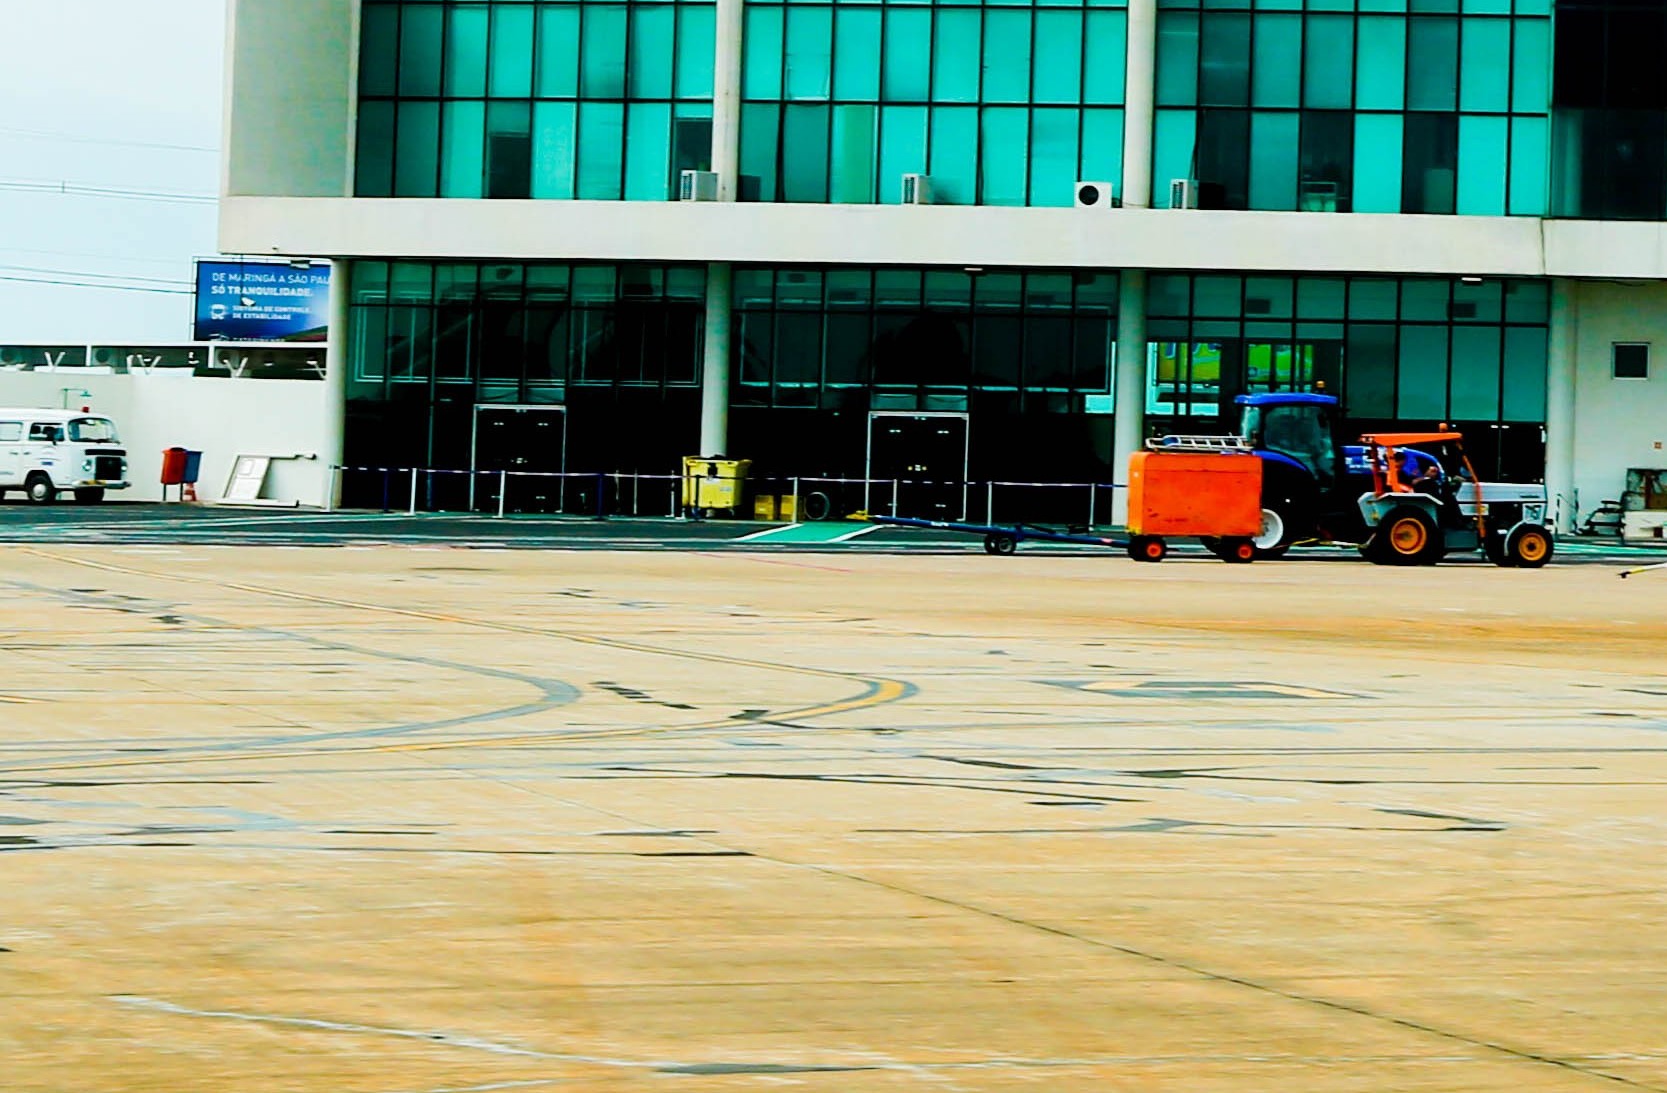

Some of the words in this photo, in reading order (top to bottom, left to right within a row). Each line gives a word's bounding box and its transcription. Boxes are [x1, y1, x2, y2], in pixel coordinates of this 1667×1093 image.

[212, 272, 226, 282] DE
[229, 272, 276, 283] MARINGÁ
[278, 275, 286, 283] A
[288, 273, 307, 284] SÃO
[211, 283, 226, 295] SÓ
